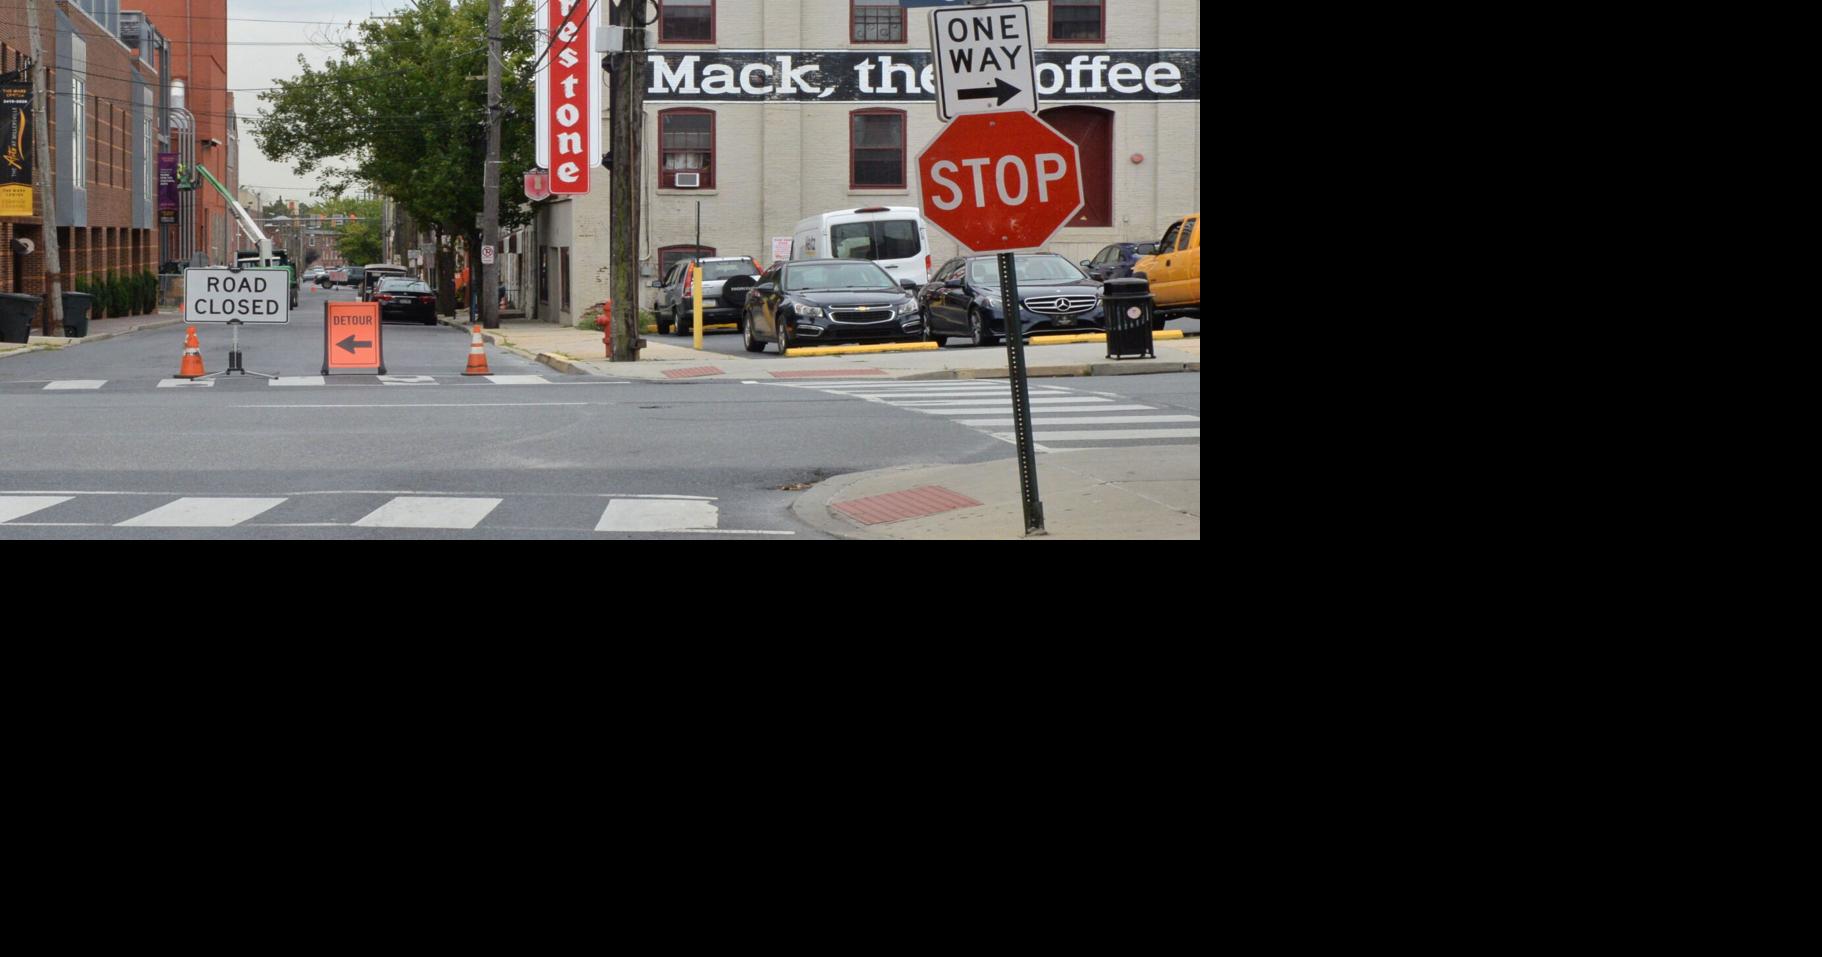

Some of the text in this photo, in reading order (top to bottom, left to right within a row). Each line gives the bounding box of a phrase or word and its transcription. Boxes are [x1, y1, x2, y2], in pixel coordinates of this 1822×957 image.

[948, 14, 1019, 42] ONE
[949, 45, 1022, 74] WAY
[647, 55, 836, 98] Mack,
[1035, 54, 1183, 95] offee
[930, 152, 1067, 211] STOP
[207, 276, 267, 293] ROAD
[194, 298, 279, 315] CLOSED
[333, 315, 373, 326] DETOUR
